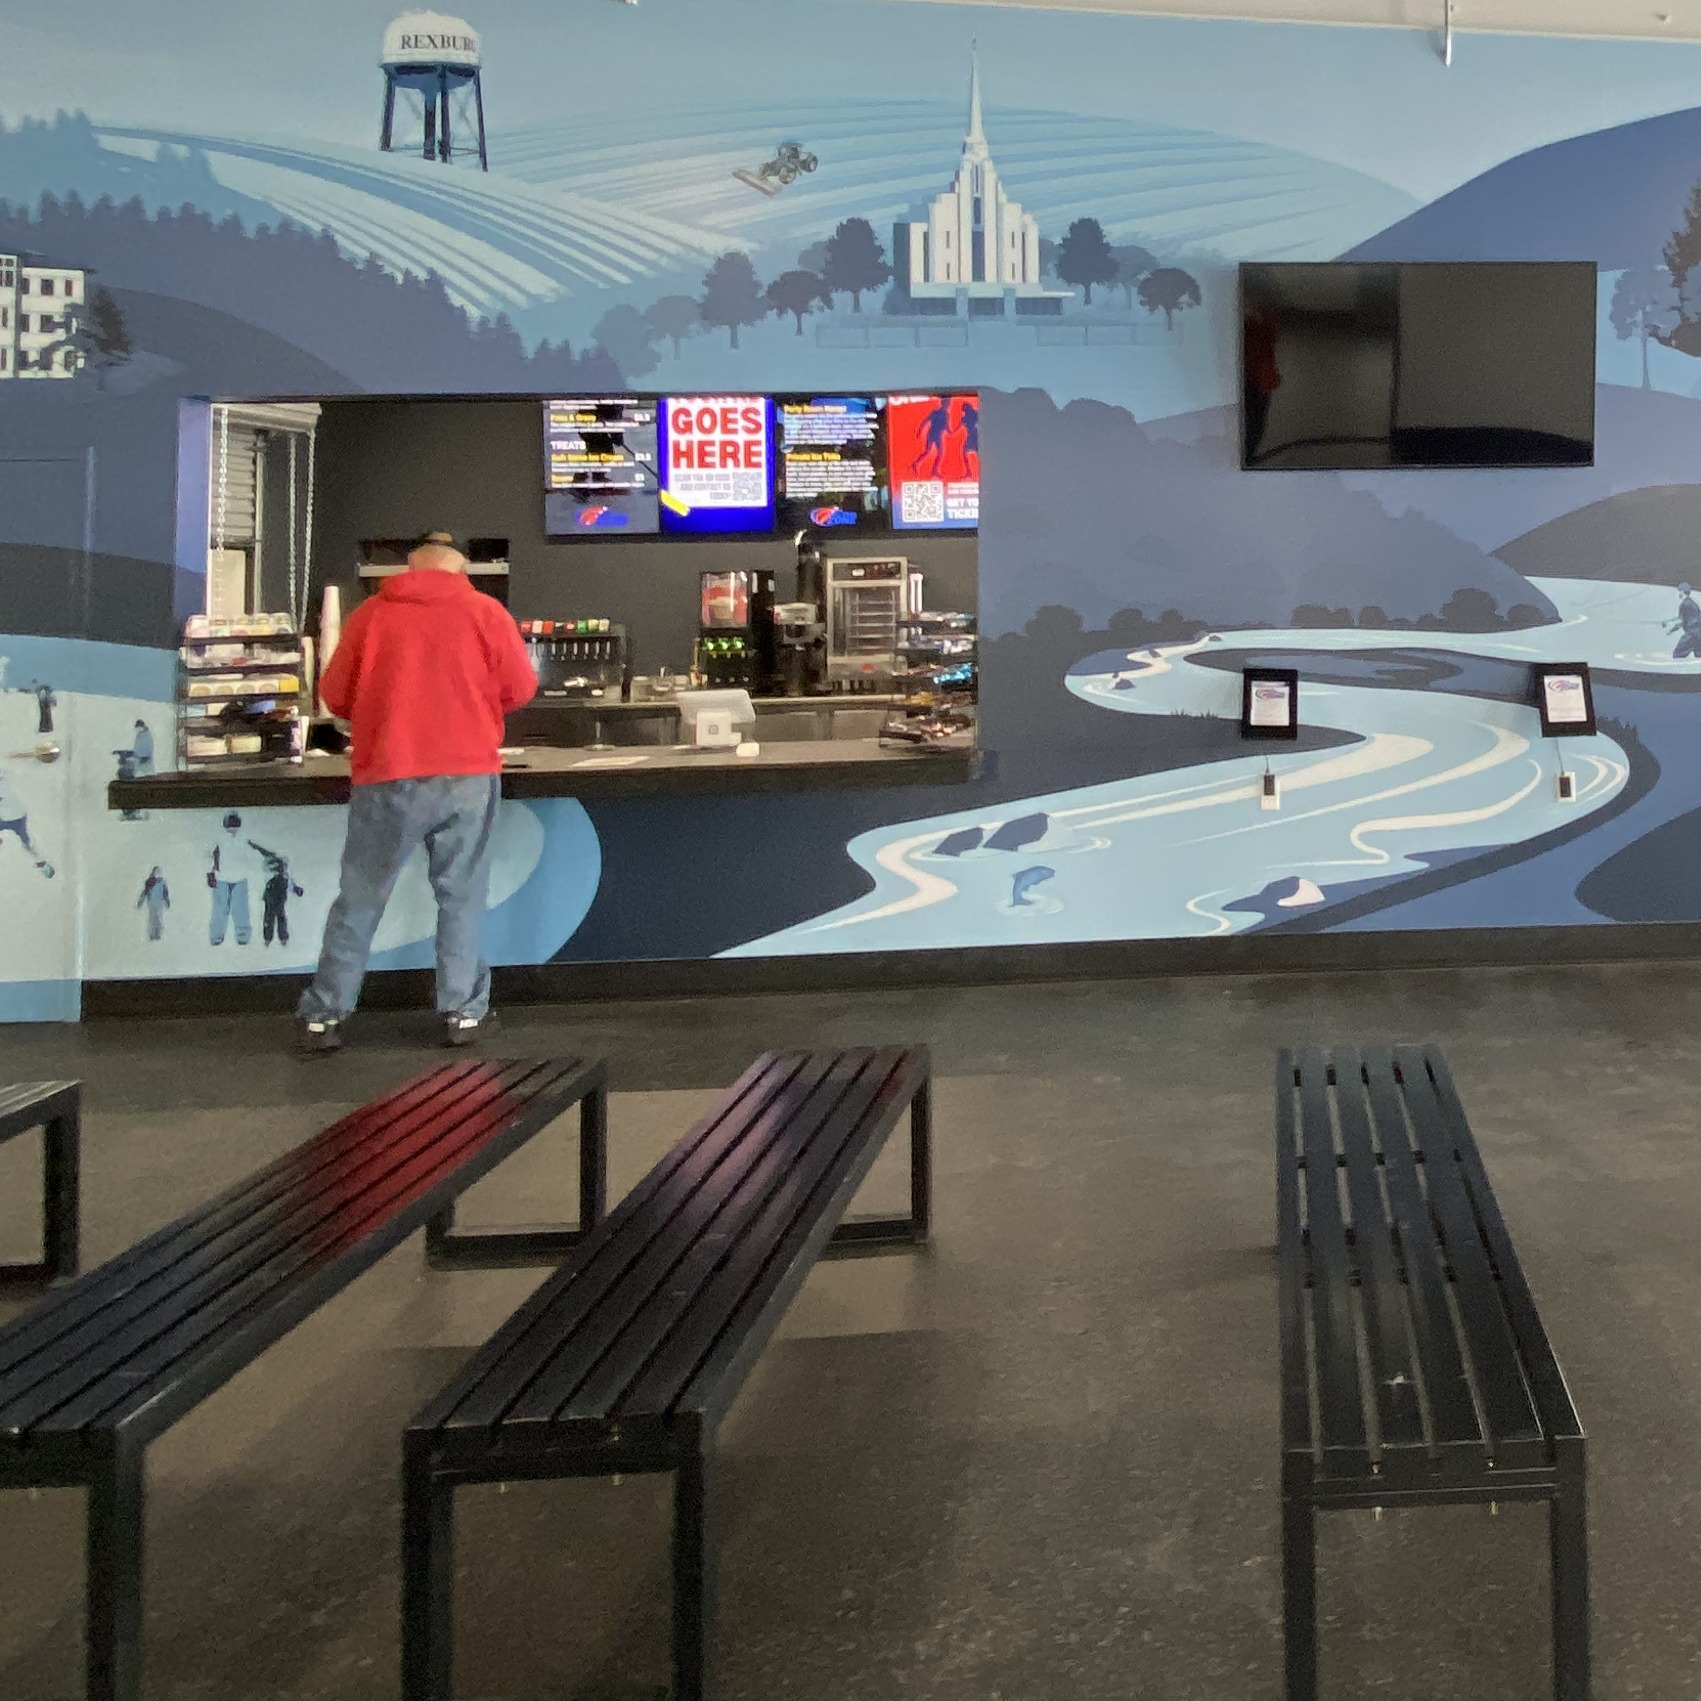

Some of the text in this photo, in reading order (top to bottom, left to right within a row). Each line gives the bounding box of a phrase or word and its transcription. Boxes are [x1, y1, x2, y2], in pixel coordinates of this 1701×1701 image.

[672, 407, 762, 434] GOES
[550, 440, 586, 450] TREATS
[673, 440, 762, 468] HERE
